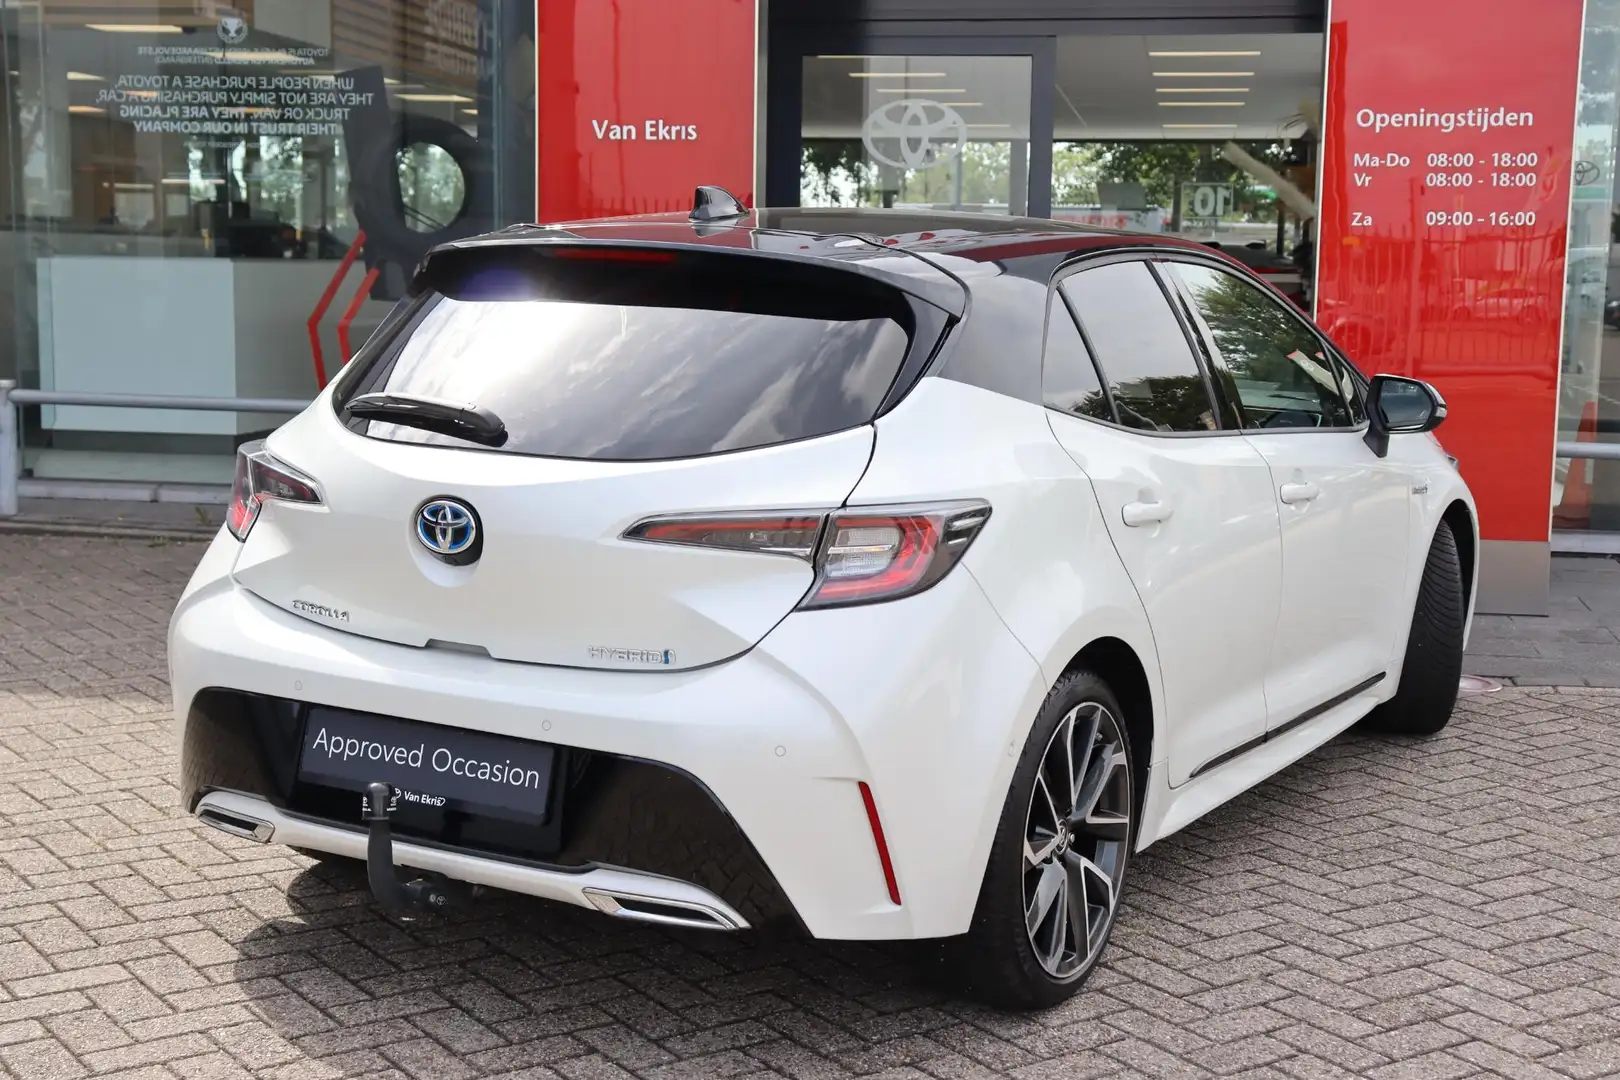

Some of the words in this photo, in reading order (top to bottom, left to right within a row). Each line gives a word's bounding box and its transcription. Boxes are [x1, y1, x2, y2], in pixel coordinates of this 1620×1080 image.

[592, 119, 636, 140] Van
[645, 118, 697, 140] Ekris
[1356, 107, 1533, 133] Openingstijden
[1353, 153, 1411, 168] Ma-Do
[1426, 153, 1474, 168] 08:00
[1491, 153, 1538, 168] 18:00
[1353, 172, 1372, 187] Vr
[1426, 172, 1473, 187] 08:00
[1490, 172, 1537, 187] 18:00
[1351, 212, 1373, 227] Za
[1426, 211, 1473, 226] 09:00
[1489, 211, 1536, 226] 16:00
[292, 600, 349, 622] COROLLA
[588, 645, 662, 664] HYBRID
[312, 727, 425, 768] Approved
[432, 748, 540, 789] Occasion
[404, 791, 420, 802] Van
[421, 794, 441, 806] Ekris
